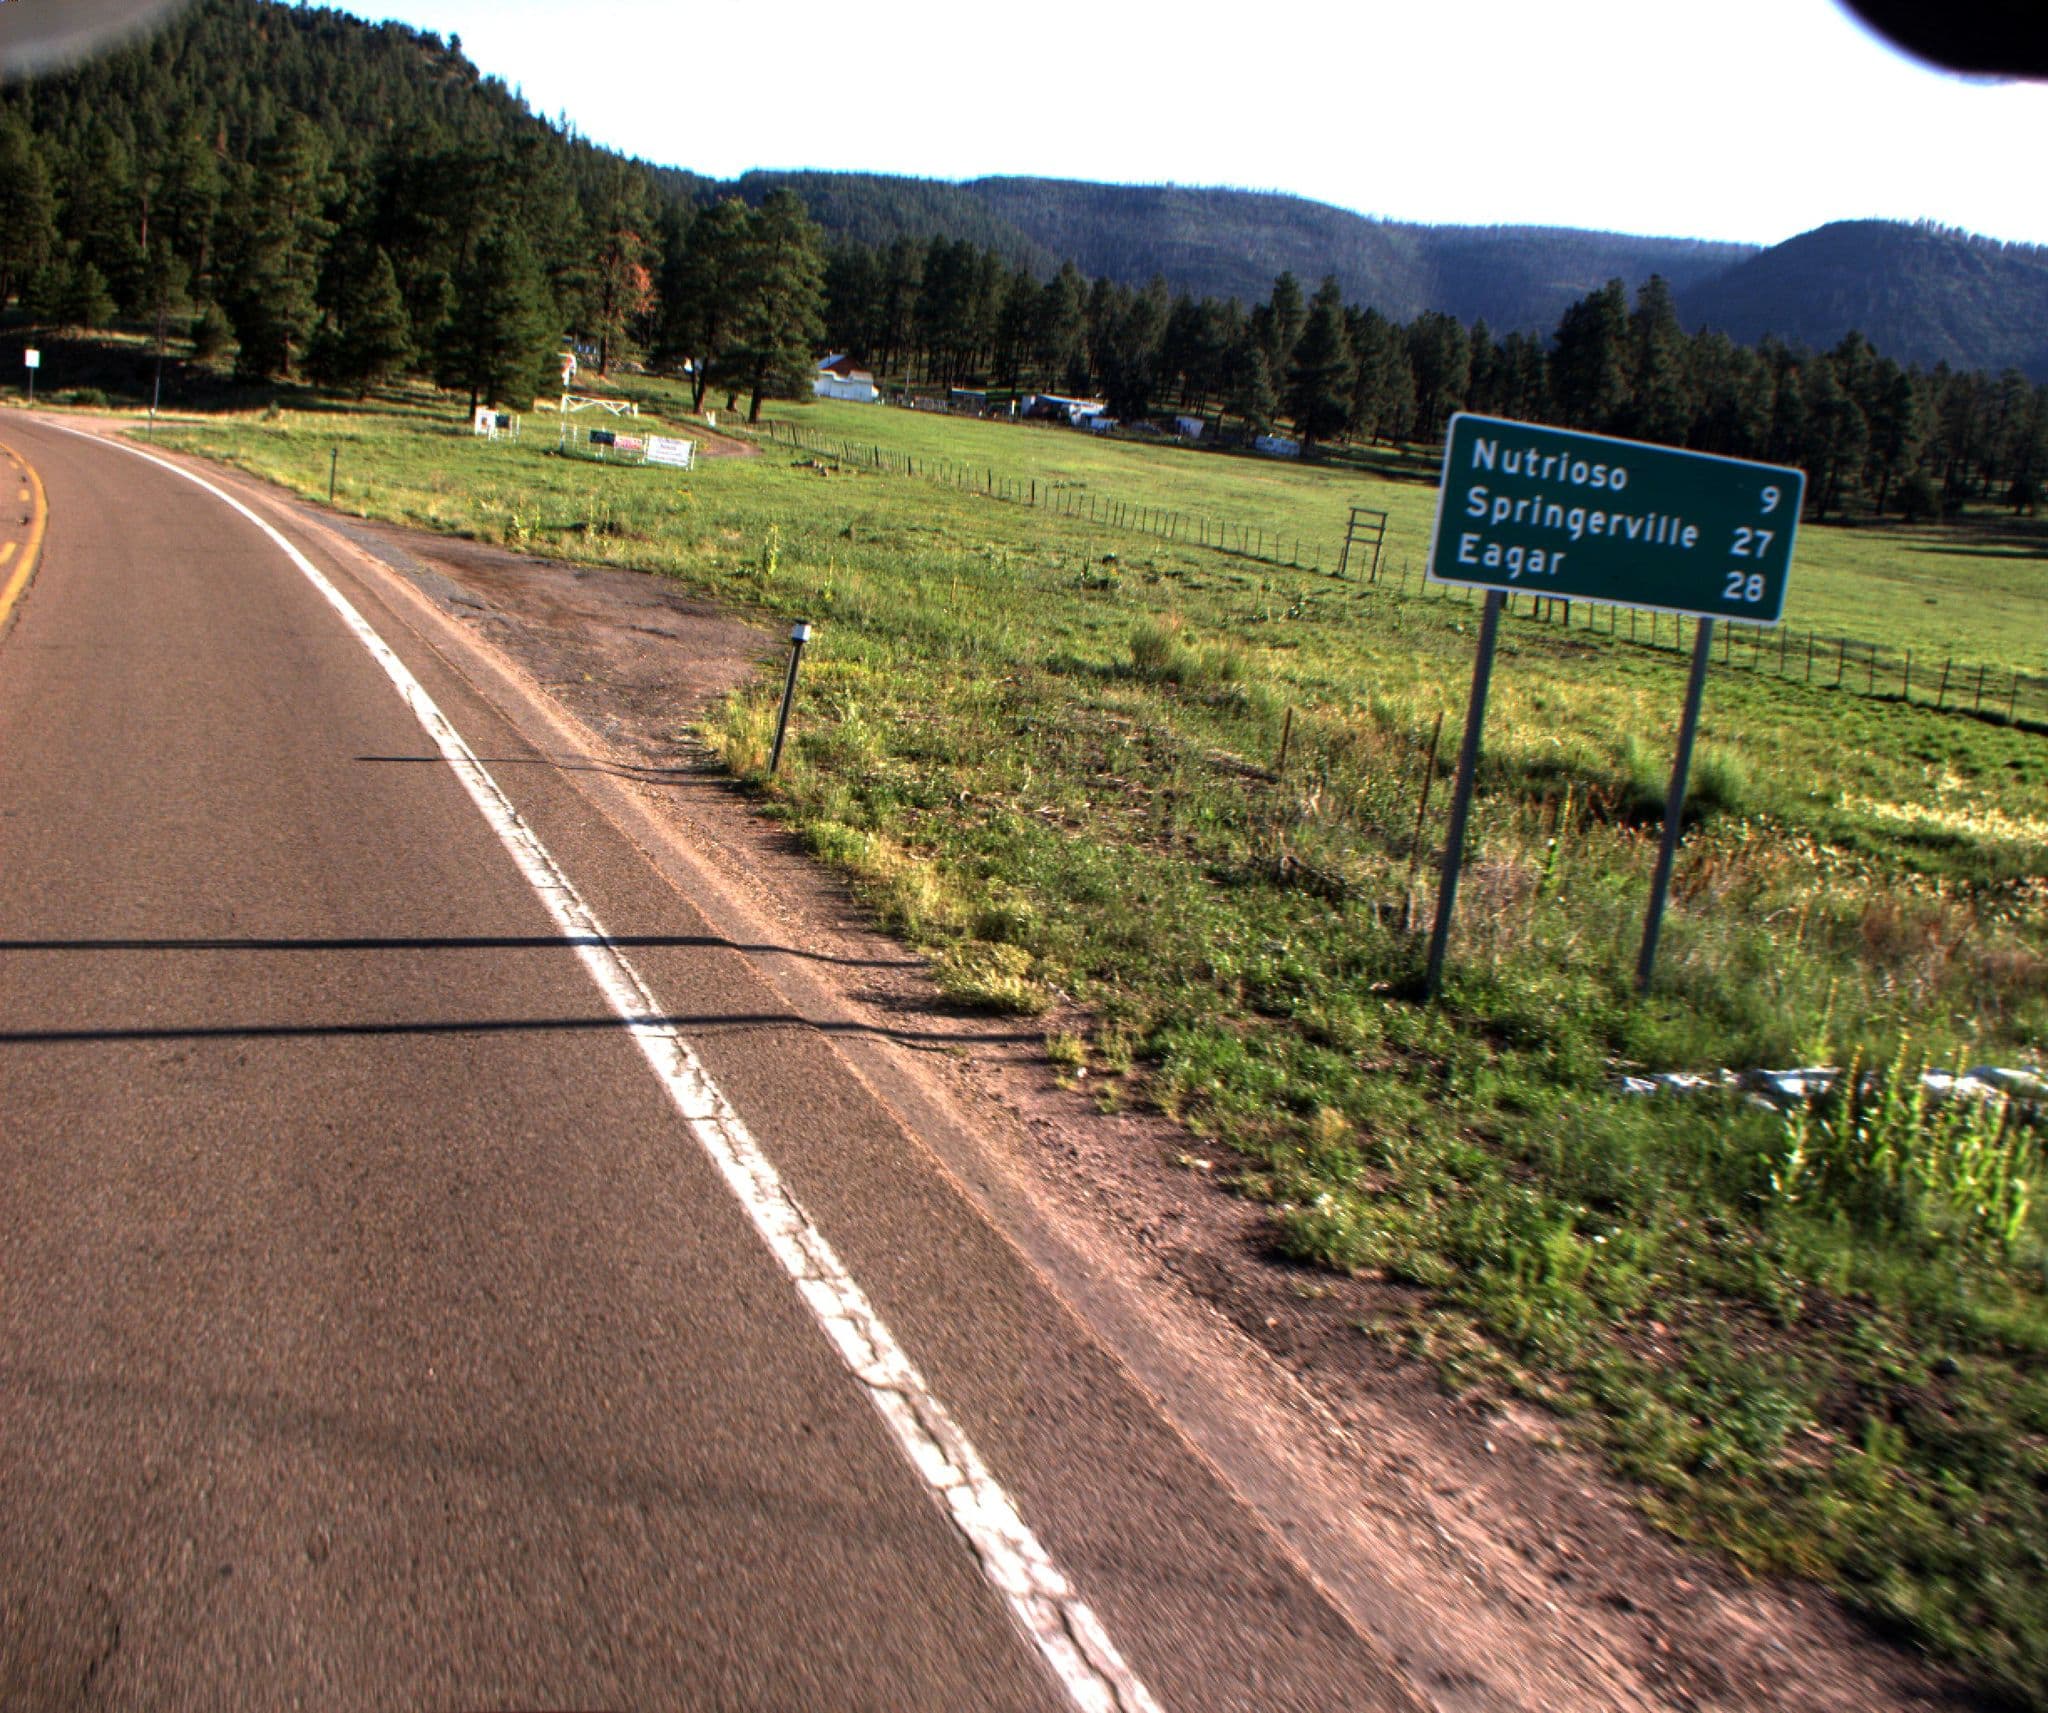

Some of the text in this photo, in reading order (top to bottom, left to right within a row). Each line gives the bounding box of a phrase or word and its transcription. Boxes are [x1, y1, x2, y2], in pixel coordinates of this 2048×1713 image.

[1471, 438, 1780, 513] Nutrioso 9
[1466, 486, 1775, 559] Springerville 27
[1457, 533, 1766, 602] Eagar 28
